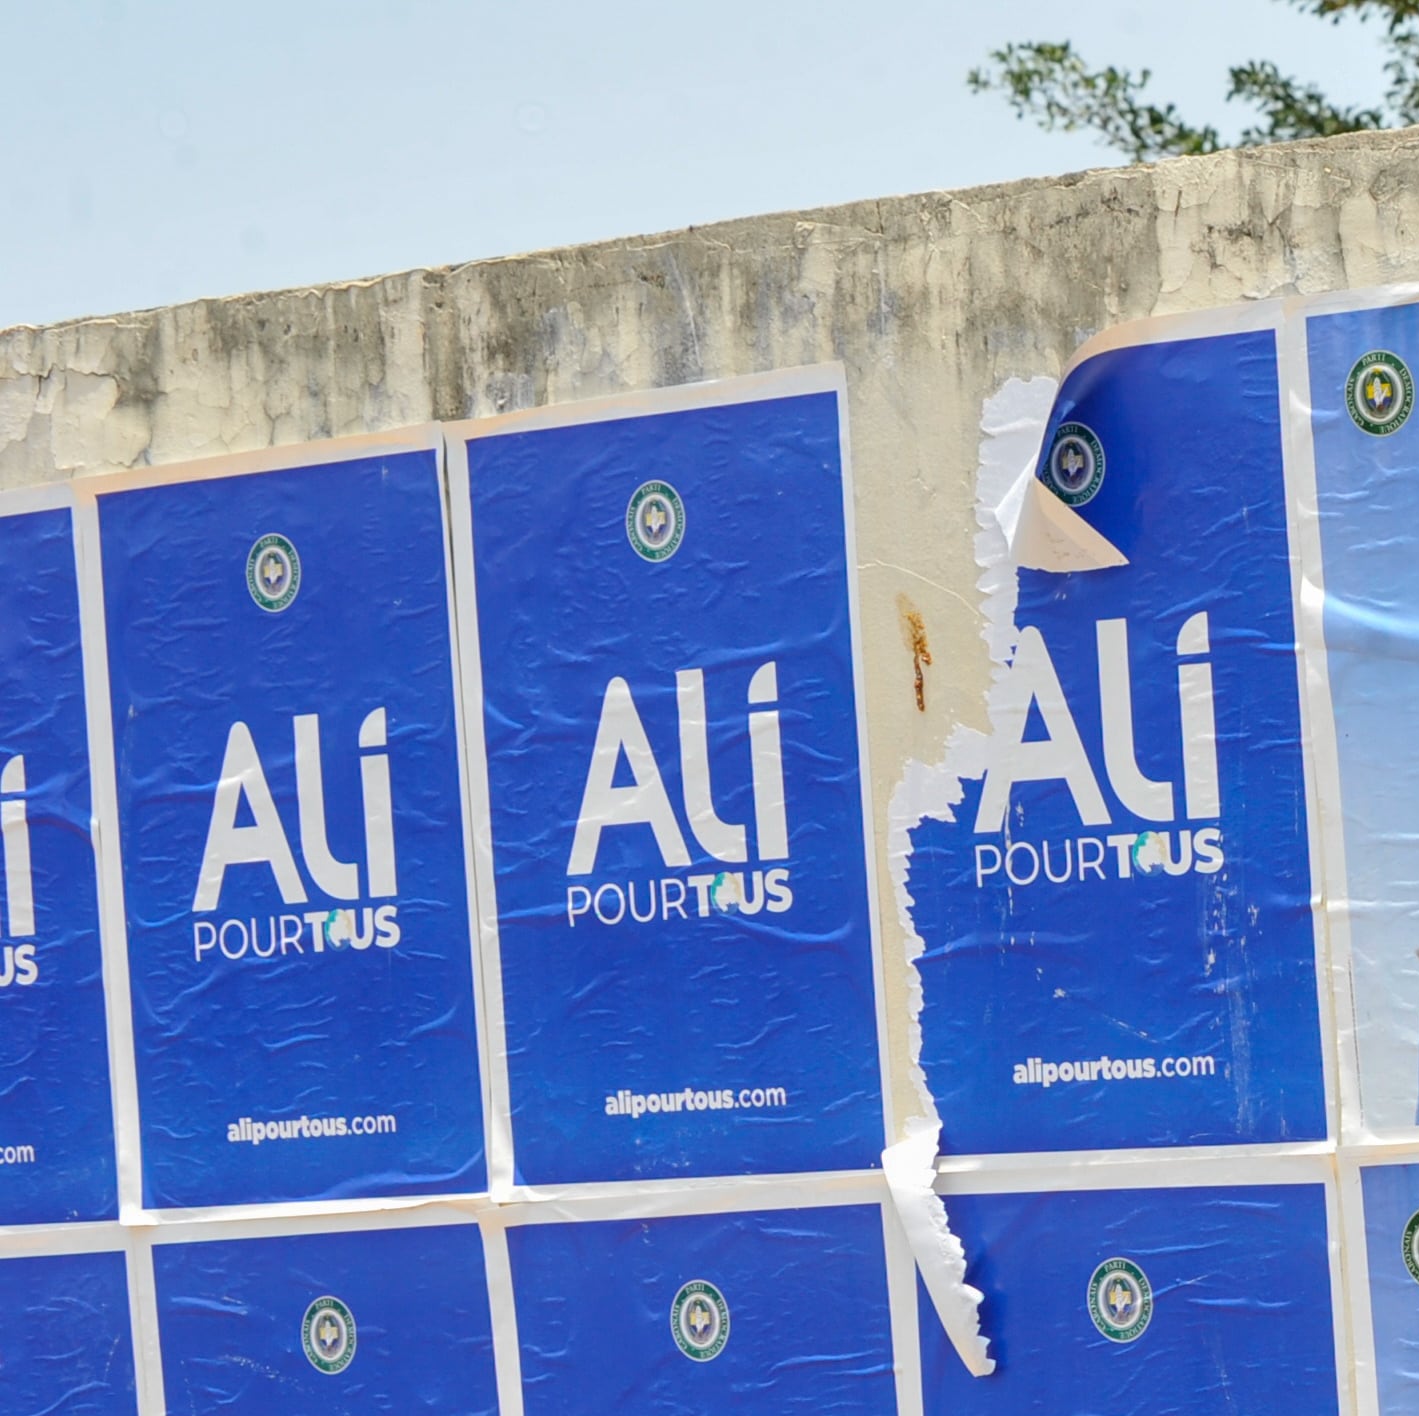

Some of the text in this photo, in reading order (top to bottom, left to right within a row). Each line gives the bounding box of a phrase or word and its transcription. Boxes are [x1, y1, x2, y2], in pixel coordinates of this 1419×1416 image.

[1361, 354, 1386, 366] PARTI
[1012, 1053, 1216, 1090] alipourtous.com
[604, 1084, 787, 1119] alipourtous.com
[226, 1110, 397, 1146] alipourtous.com
